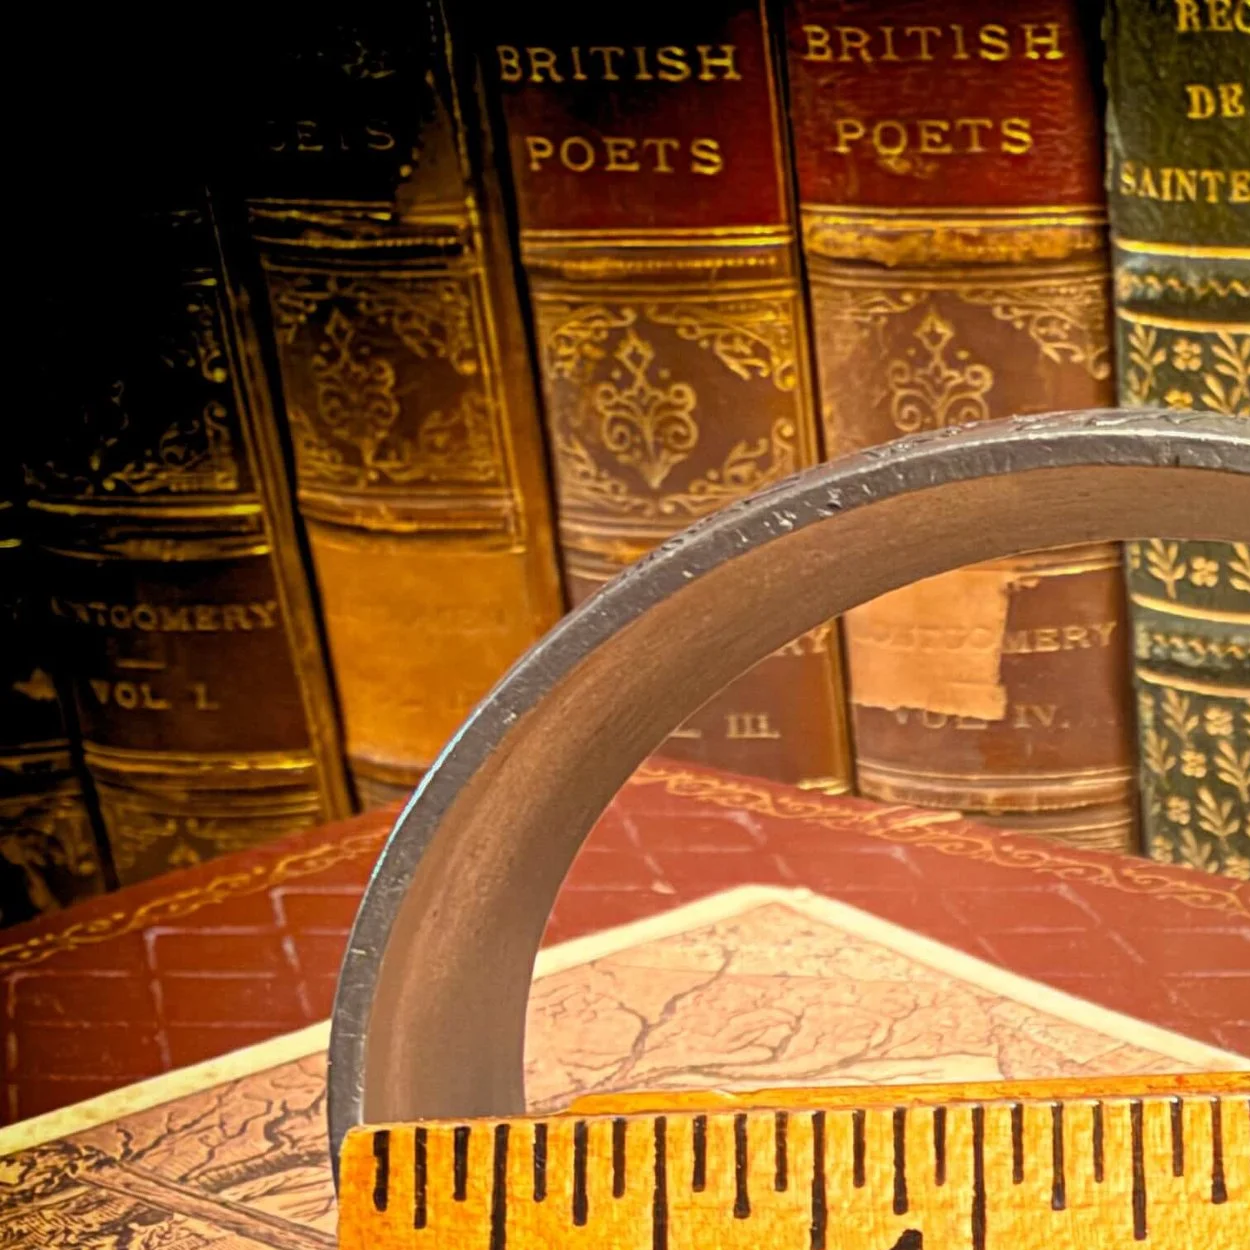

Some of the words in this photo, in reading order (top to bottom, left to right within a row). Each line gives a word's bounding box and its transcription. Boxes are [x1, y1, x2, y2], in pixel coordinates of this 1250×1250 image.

[802, 23, 1066, 63] BRITISH
[496, 44, 743, 83] BRITISH
[1185, 82, 1247, 120] DE
[833, 116, 1034, 154] POETS
[525, 136, 724, 176] POETS
